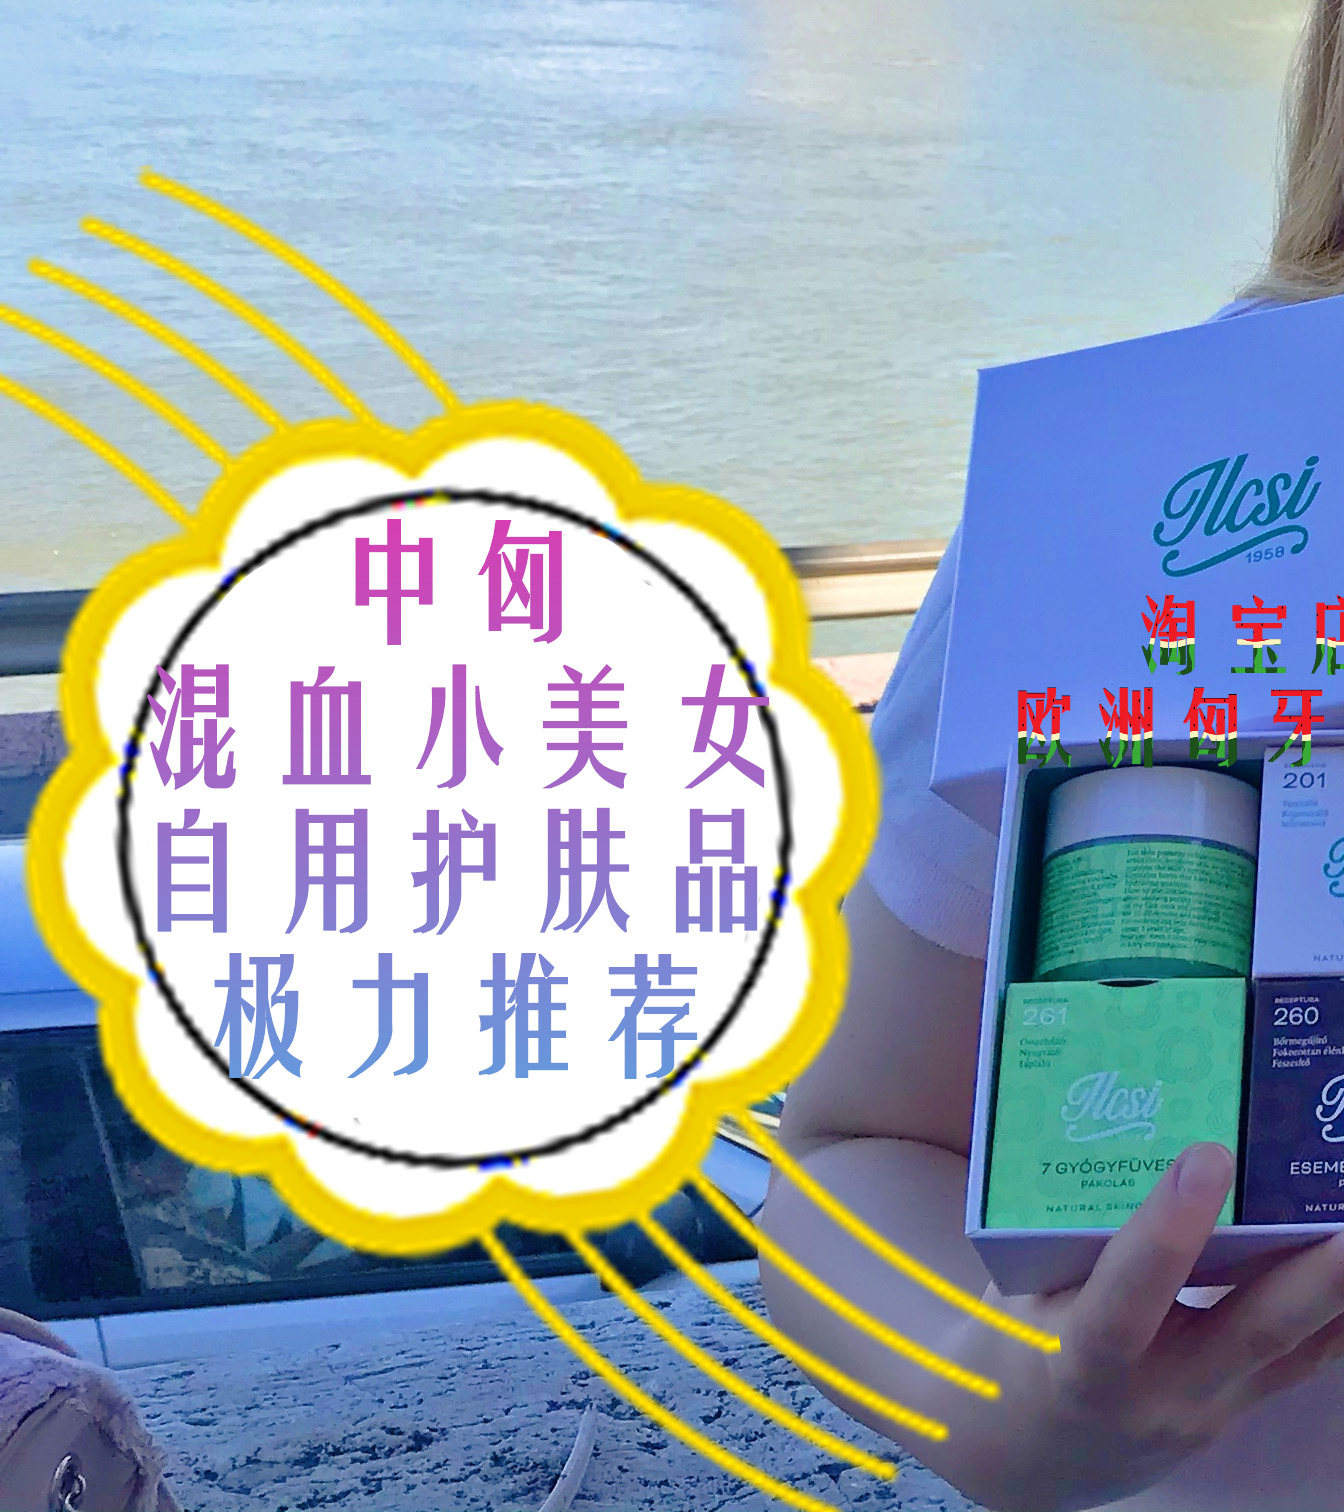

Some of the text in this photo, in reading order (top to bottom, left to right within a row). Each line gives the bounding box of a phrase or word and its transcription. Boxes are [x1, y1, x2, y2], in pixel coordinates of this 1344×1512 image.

[1153, 453, 1322, 547] Ilcsi
[1245, 546, 1285, 563] 1958
[1283, 772, 1326, 789] 201
[1023, 1007, 1068, 1026] 261
[1273, 1006, 1320, 1026] 260
[1061, 1071, 1164, 1122] Ilcsi
[1041, 1162, 1052, 1175] 7
[1046, 1202, 1142, 1213] NATURAL SKINC
